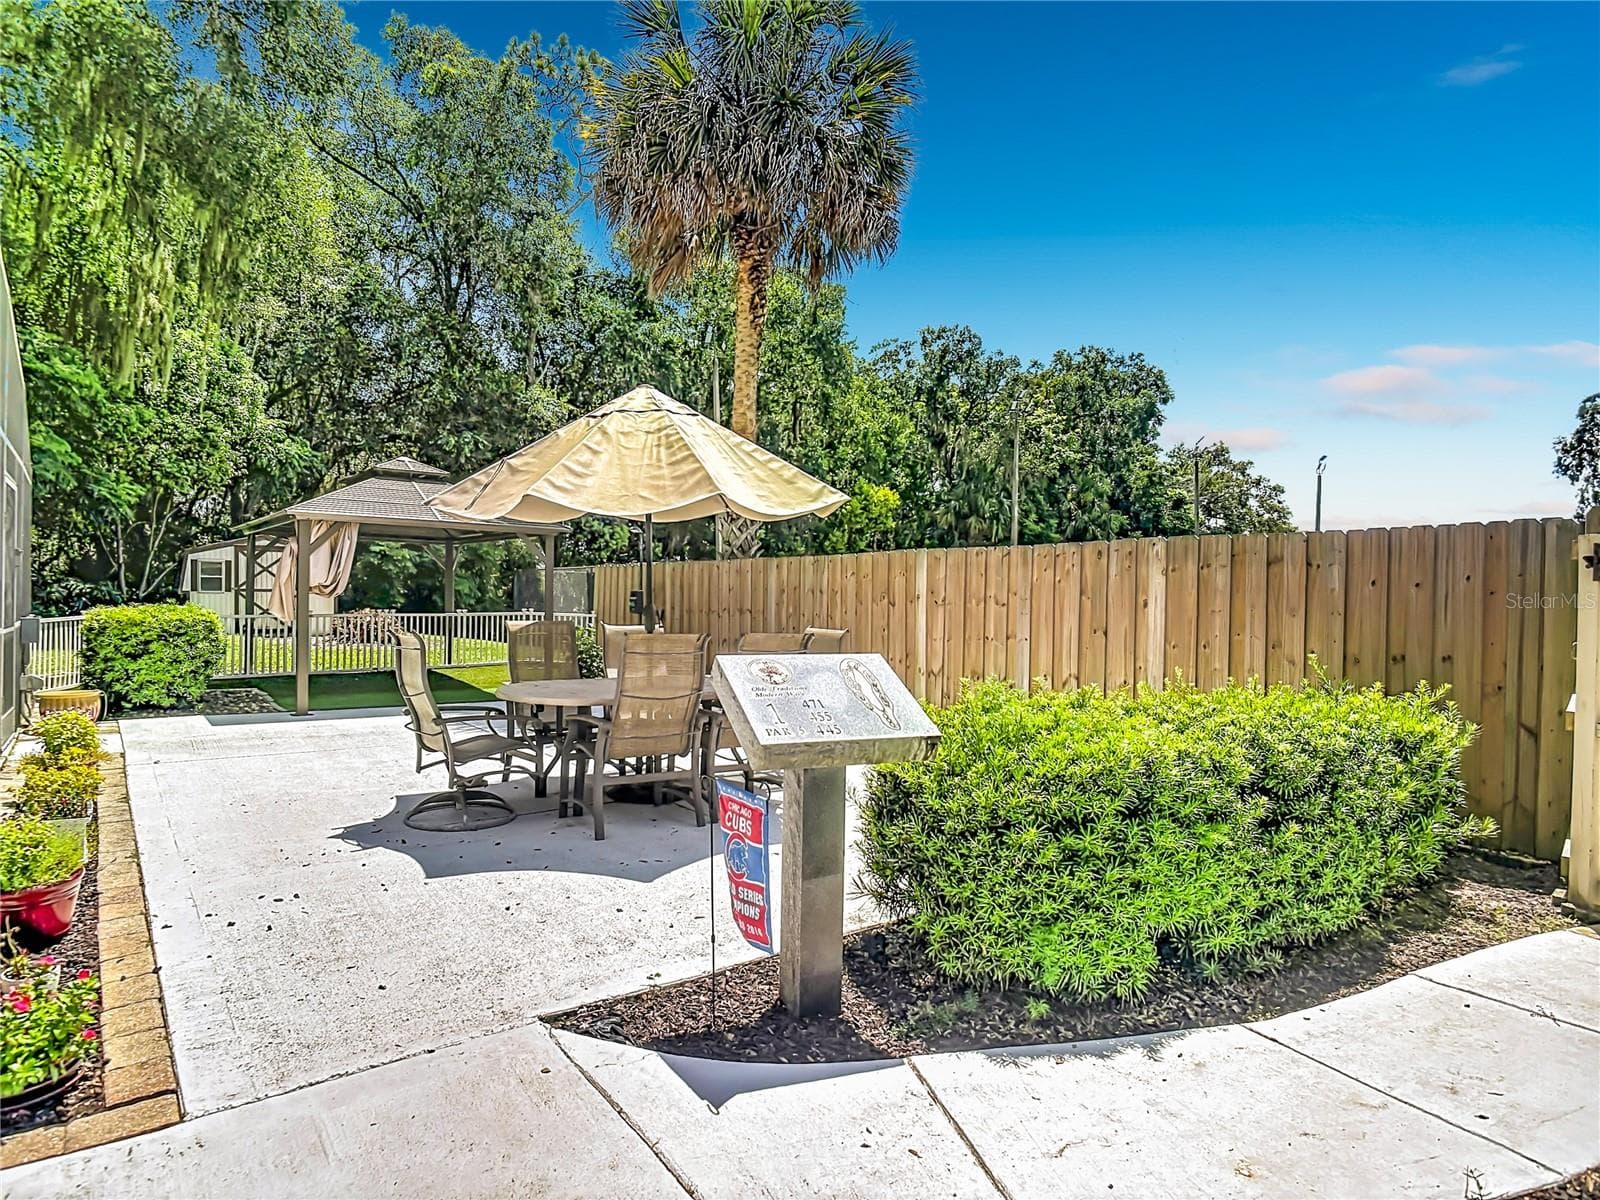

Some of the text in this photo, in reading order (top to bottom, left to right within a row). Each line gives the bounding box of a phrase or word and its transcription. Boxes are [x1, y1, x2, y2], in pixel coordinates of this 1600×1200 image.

[802, 699, 825, 709] 471
[766, 703, 786, 724] 1
[810, 711, 833, 722] 455
[765, 726, 806, 737] PAR 5
[816, 724, 842, 736] 445
[728, 801, 752, 818] CHICAGO
[725, 811, 752, 837] CUBS
[738, 886, 764, 906] SERIES
